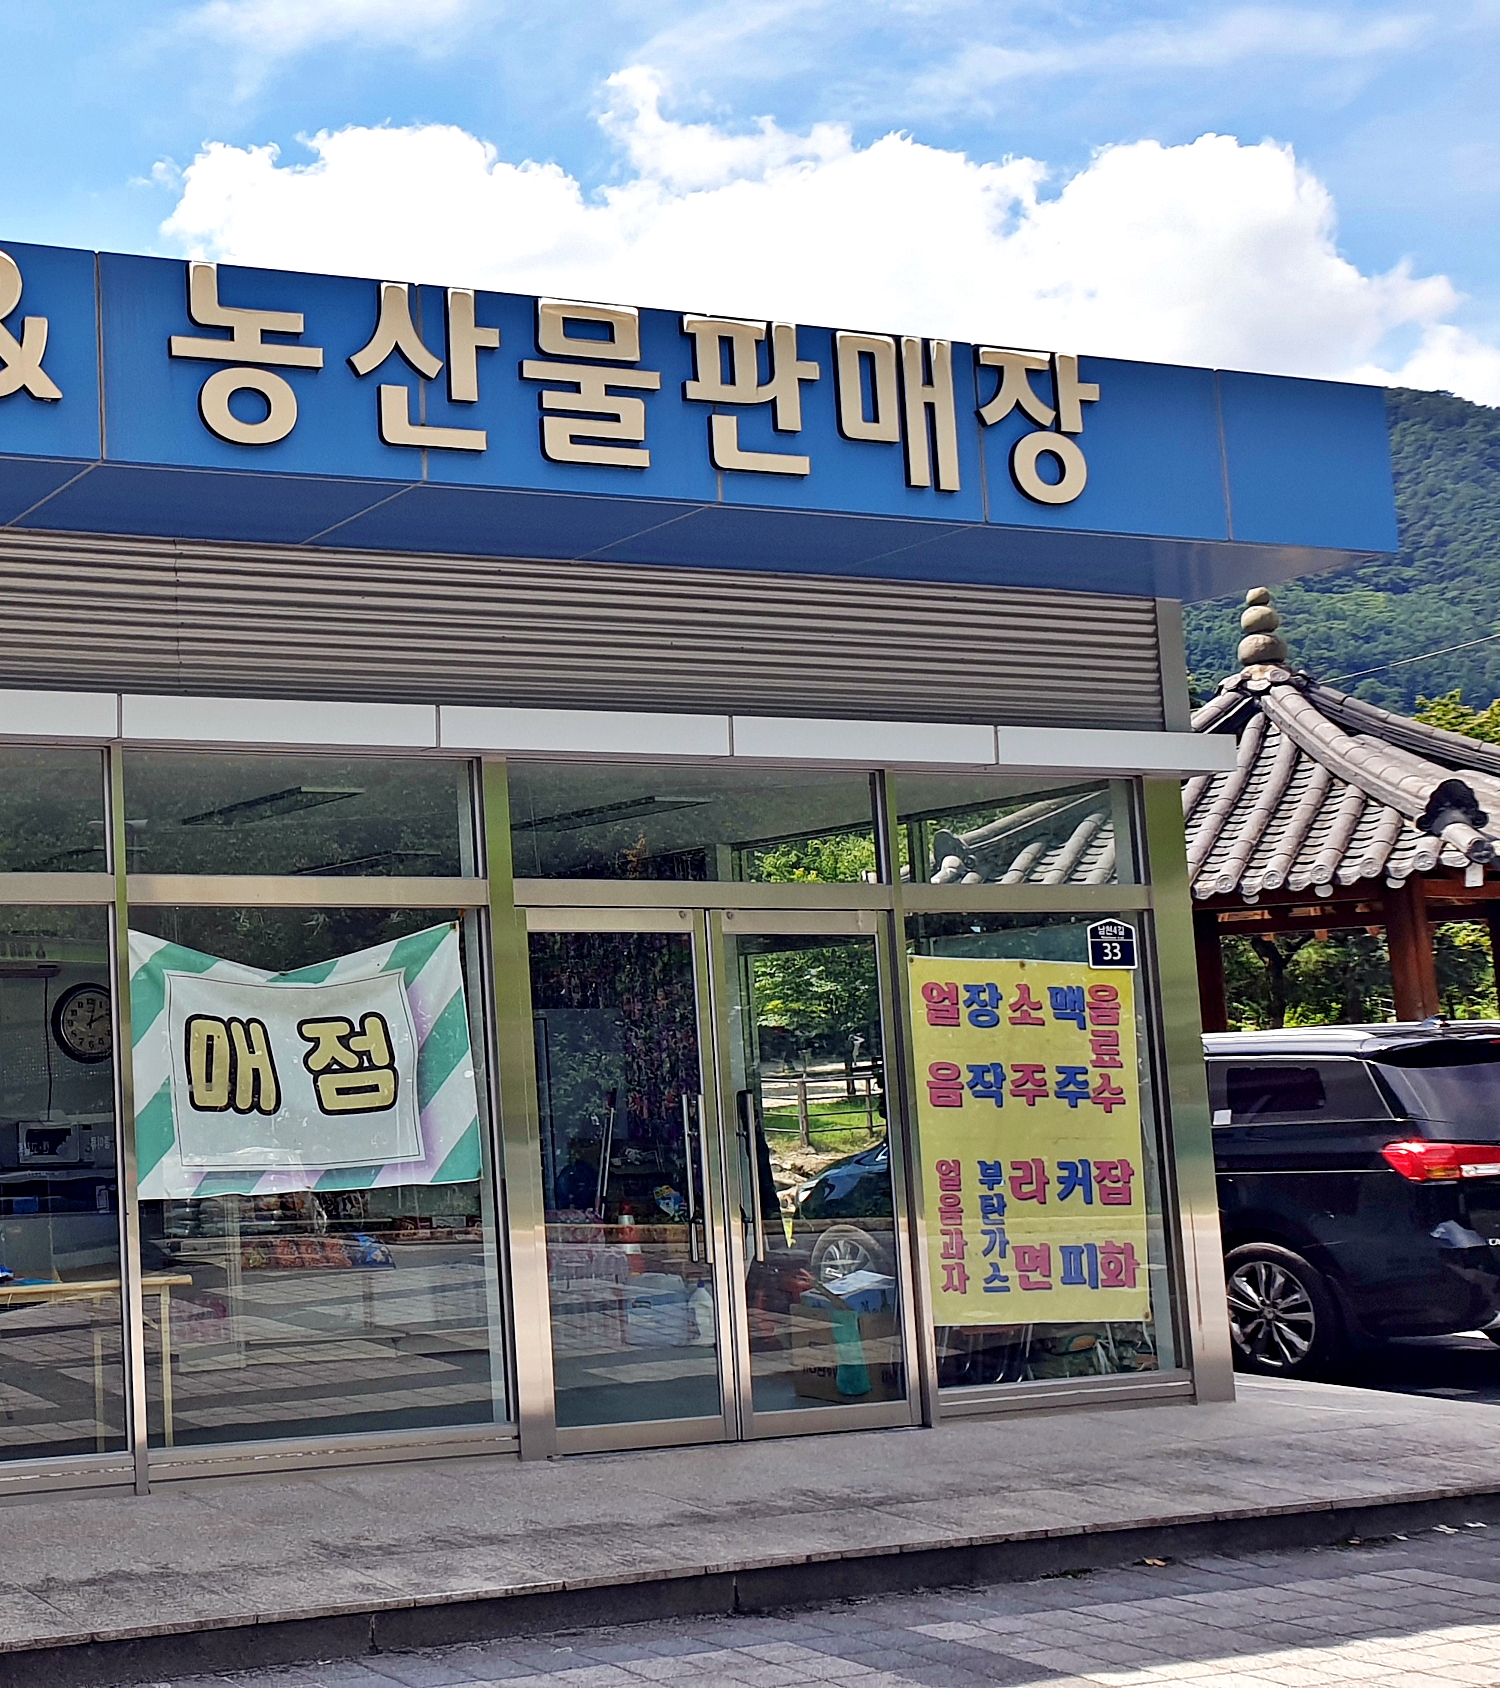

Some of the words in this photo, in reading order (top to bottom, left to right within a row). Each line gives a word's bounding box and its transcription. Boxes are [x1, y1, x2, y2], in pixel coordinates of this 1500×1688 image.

[169, 260, 1100, 505] 농산물판매장
[1102, 942, 1122, 961] 33
[185, 1012, 400, 1116] 매점
[1086, 984, 1125, 1113] 음료수
[935, 1159, 969, 1294] 얼음과자
[977, 1160, 1010, 1293] 부탄가스
